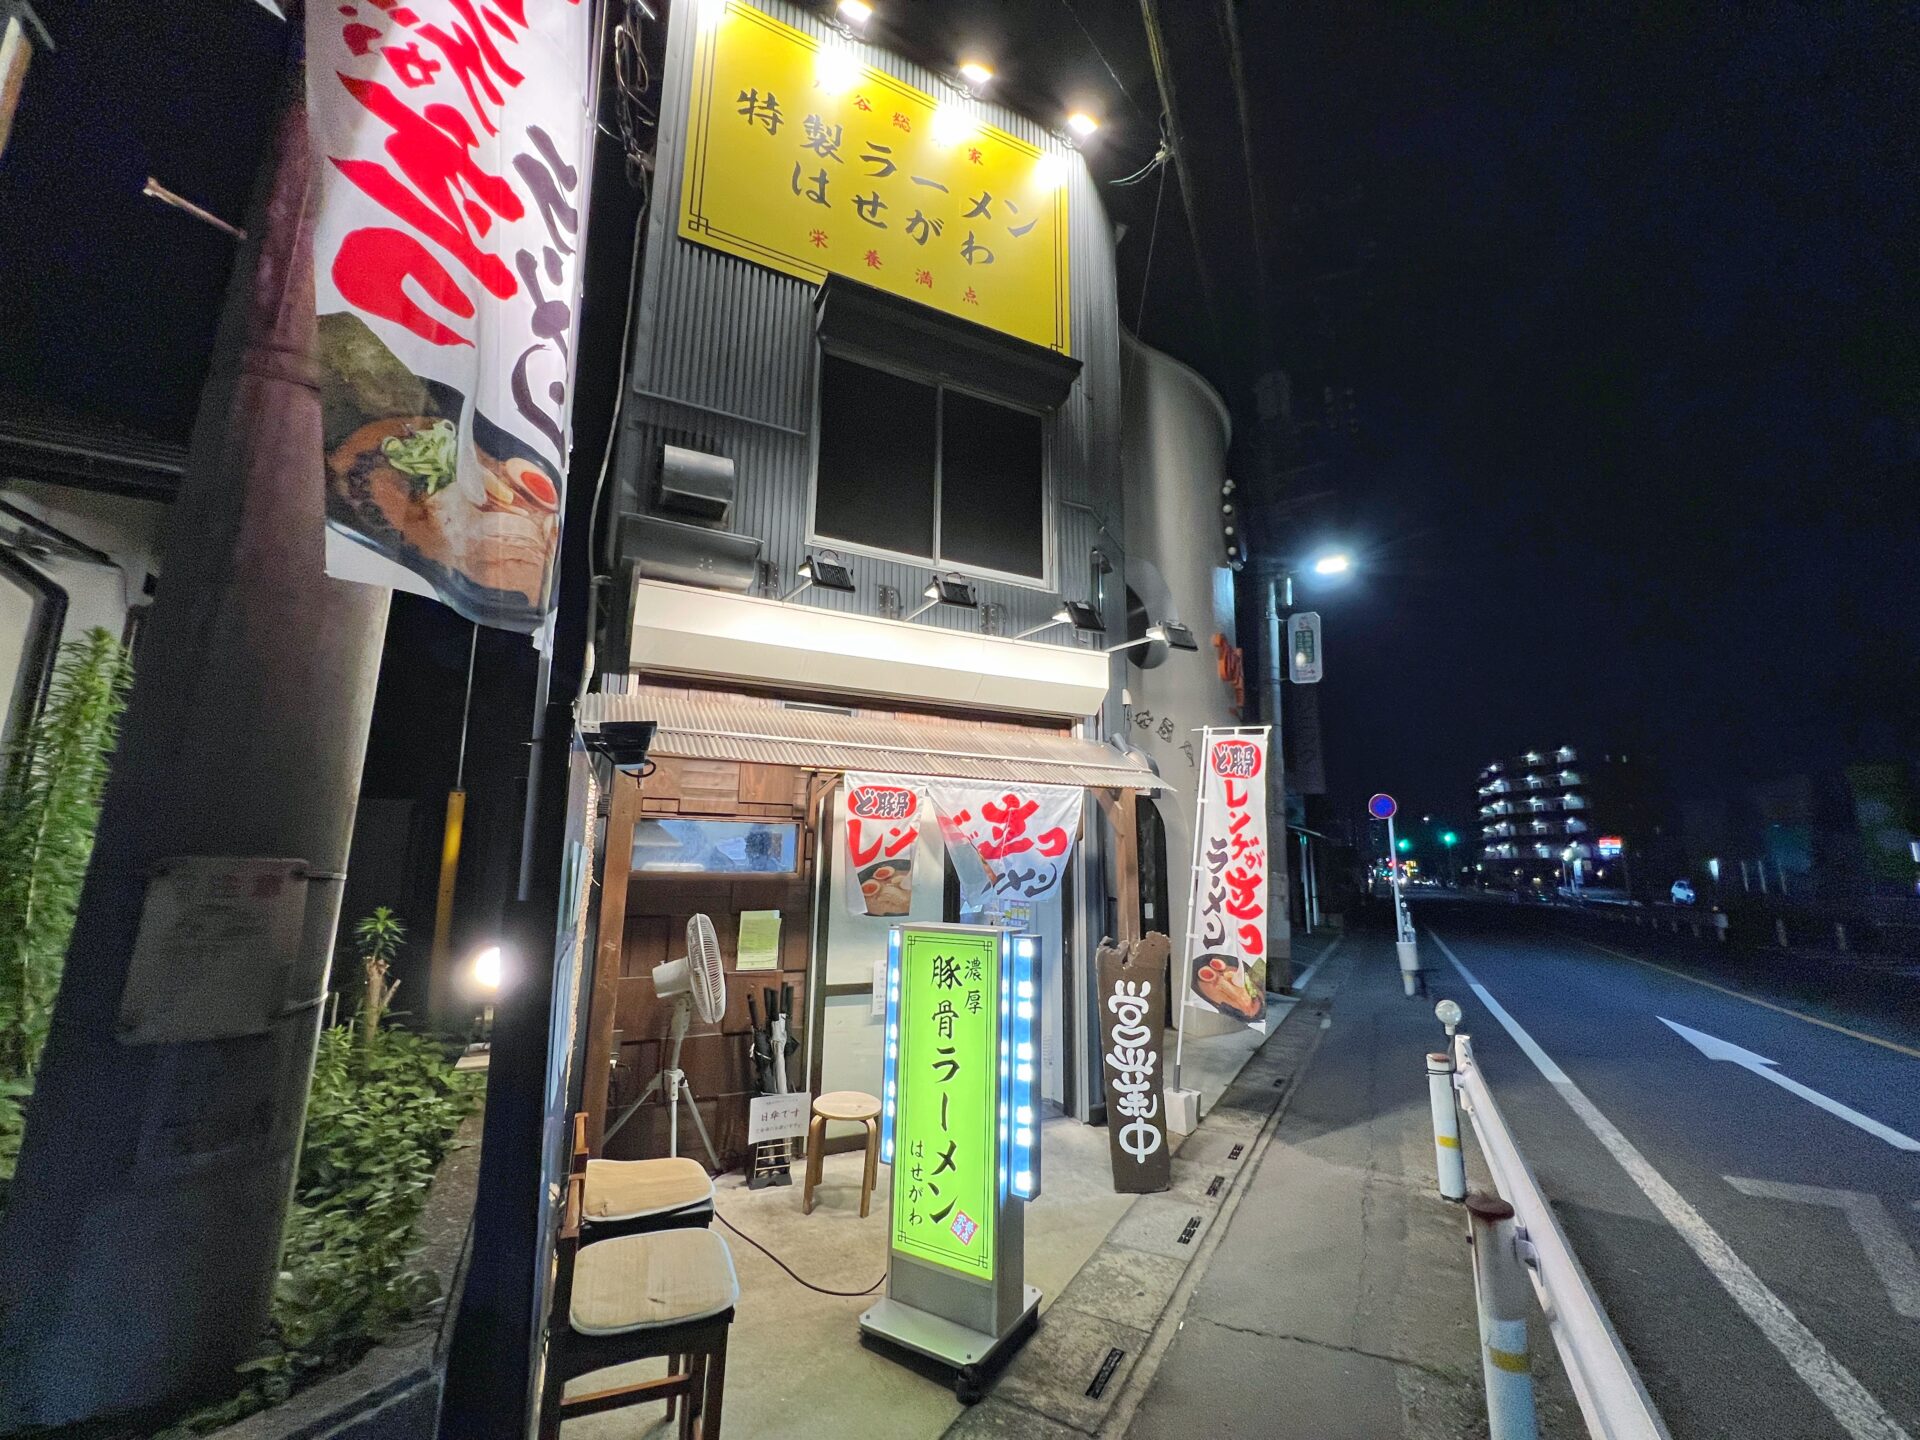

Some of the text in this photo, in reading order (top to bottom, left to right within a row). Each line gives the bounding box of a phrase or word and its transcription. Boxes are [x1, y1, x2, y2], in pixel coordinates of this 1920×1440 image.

[737, 88, 1039, 238] 特製ラーメン
[791, 161, 994, 265] はせがわ
[809, 229, 979, 305] 栄養満点
[1202, 837, 1228, 950] ラーメン
[1224, 779, 1265, 955] レンゲが立つ
[963, 957, 983, 1015] 濃厚
[928, 954, 964, 1225] 豚骨ラーメン
[907, 1138, 925, 1227] はせがわ
